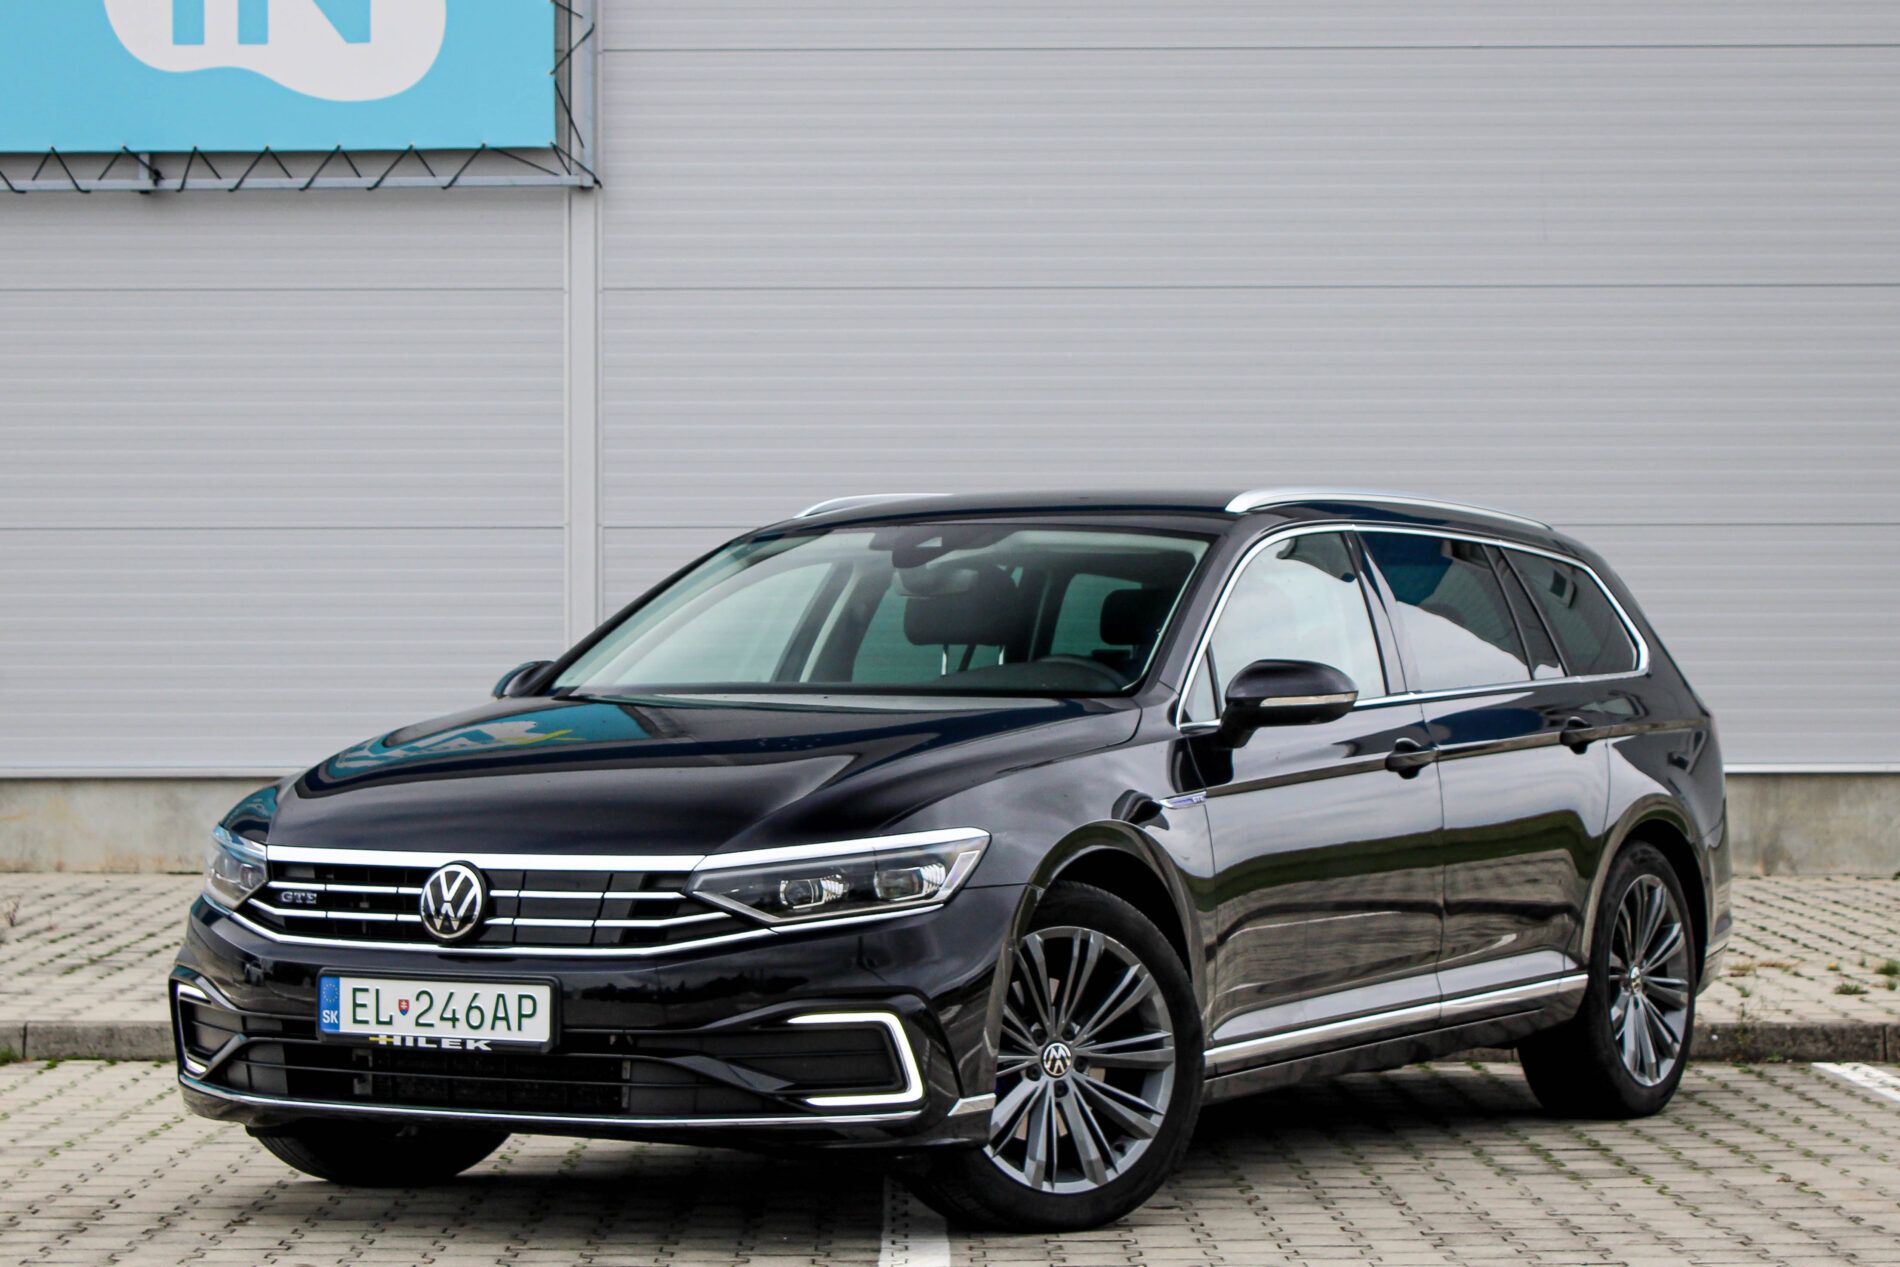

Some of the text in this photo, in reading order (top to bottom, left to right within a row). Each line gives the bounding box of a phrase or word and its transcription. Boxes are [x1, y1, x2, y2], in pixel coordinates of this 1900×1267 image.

[281, 891, 317, 905] GTE
[322, 1009, 338, 1024] SK
[352, 987, 538, 1032] EL 246AP
